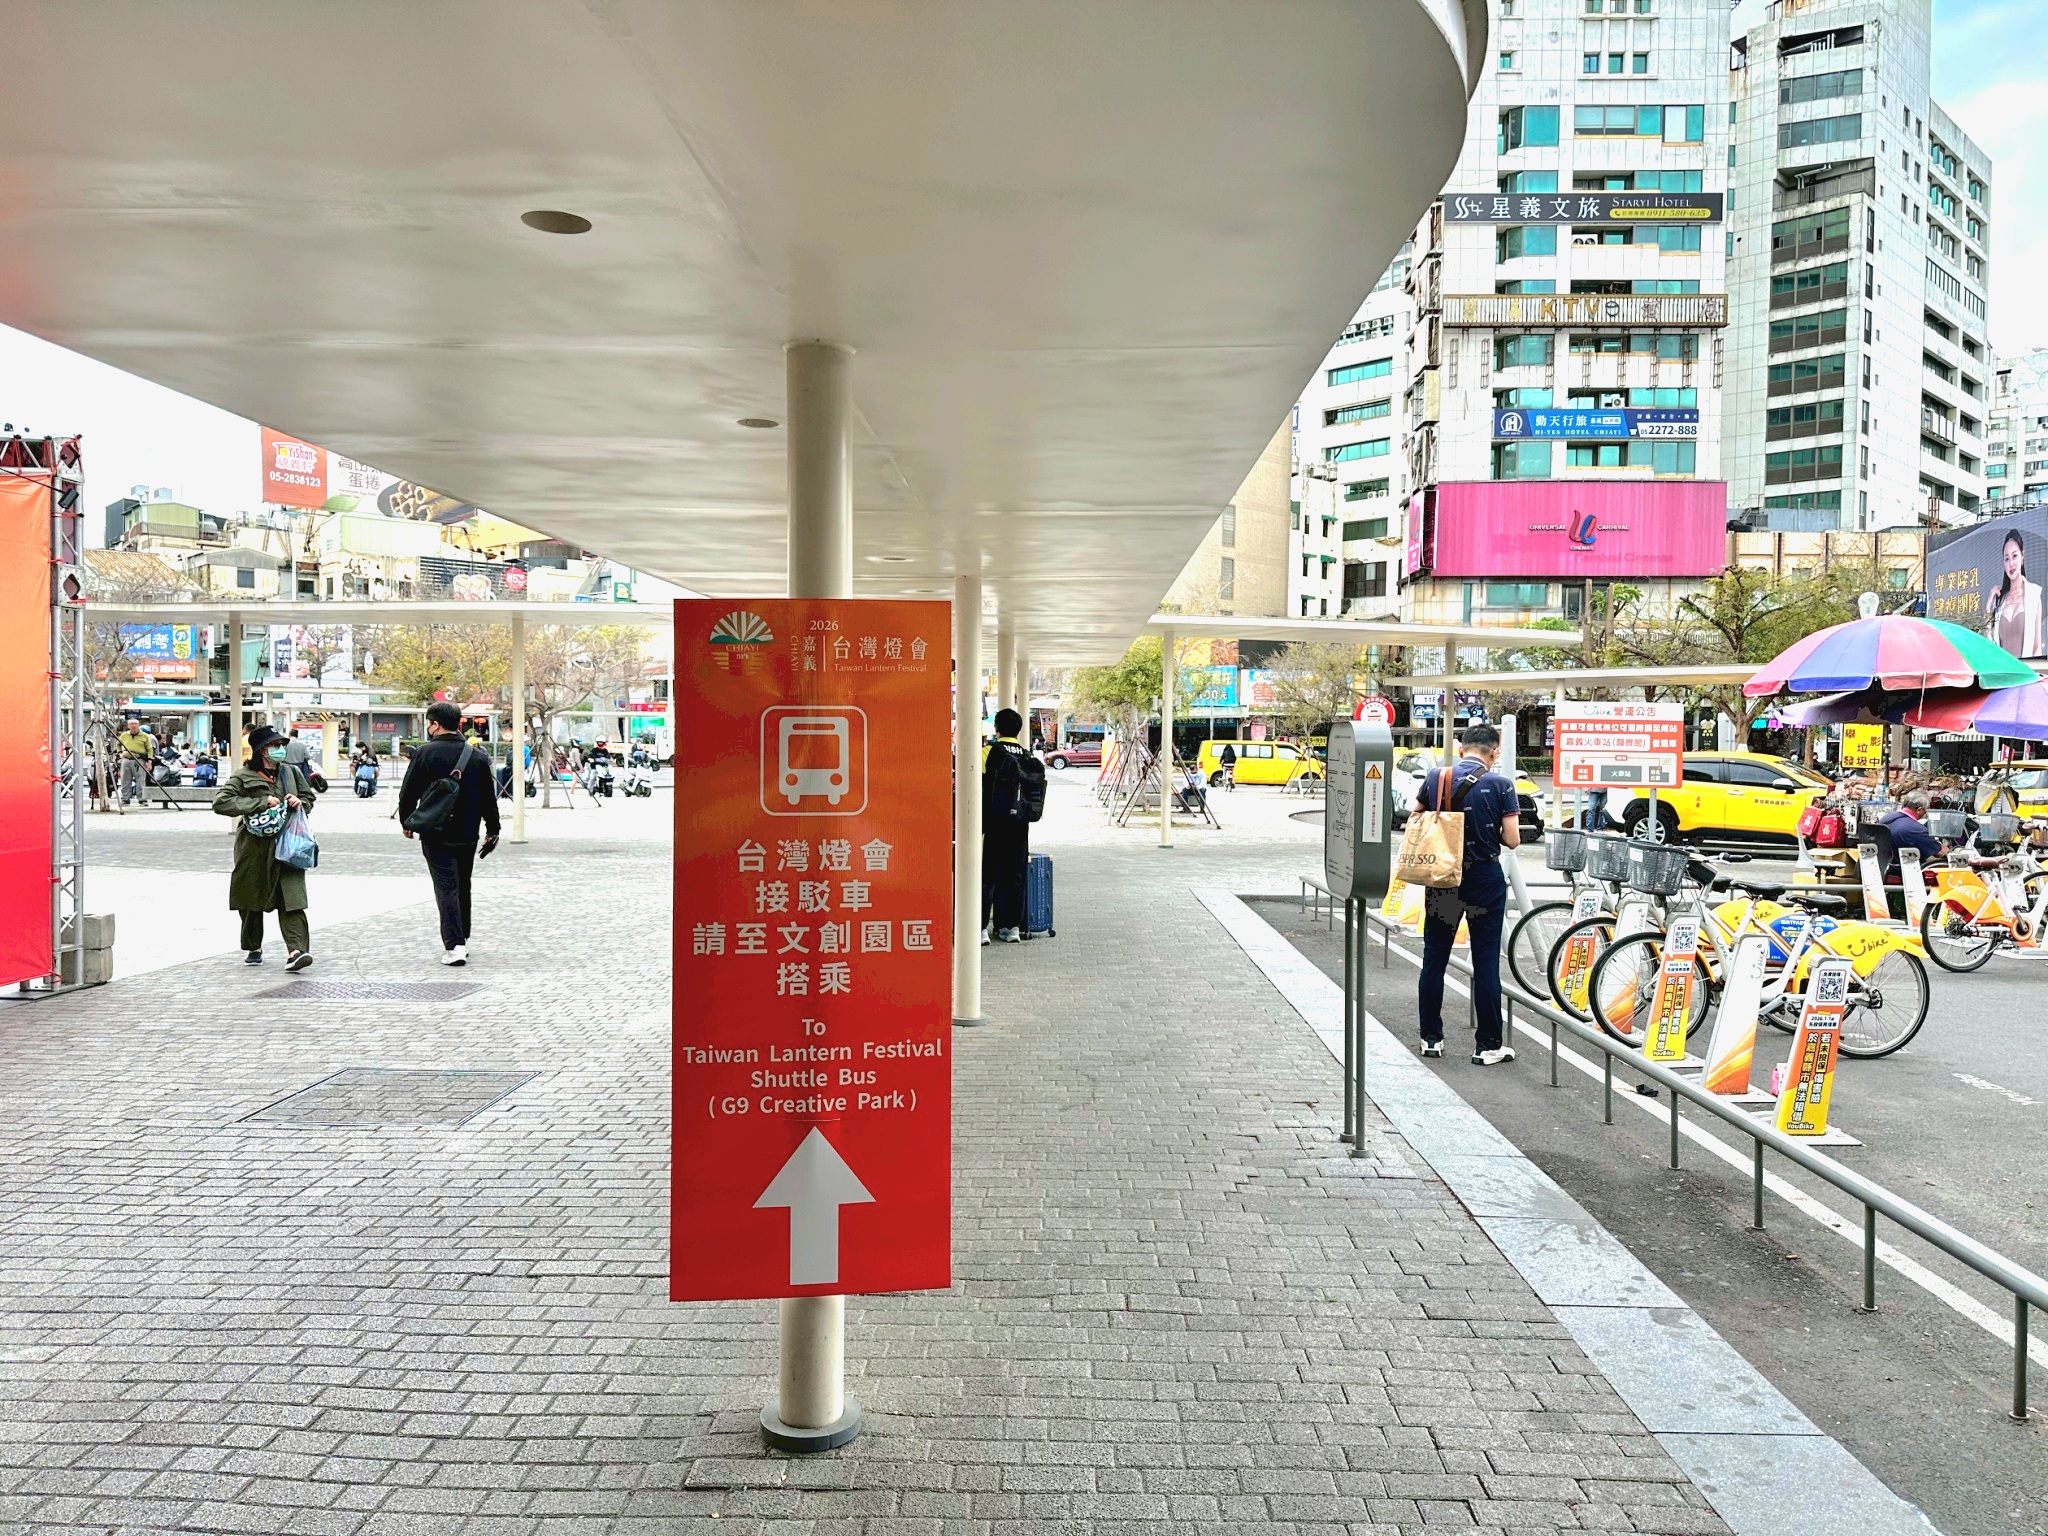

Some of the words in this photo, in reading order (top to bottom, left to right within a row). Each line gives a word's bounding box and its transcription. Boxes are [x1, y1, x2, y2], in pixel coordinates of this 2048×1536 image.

[1490, 197, 1600, 219] 星義文旅
[1655, 197, 1692, 207] HOTEL
[1540, 299, 1600, 319] KTV
[1648, 425, 1698, 435] 2272-888
[269, 470, 321, 488] 05-2838123
[348, 471, 381, 491] 蛋捲
[1934, 567, 1980, 593] 專業隆乳
[1934, 592, 1980, 616] 醫療團隊
[810, 620, 839, 631] 2026
[791, 635, 799, 672] CHIAYI
[803, 636, 817, 672] 嘉義
[832, 636, 929, 661] 台灣燈會
[834, 664, 863, 672] Taiwan
[865, 663, 895, 672] Lantern
[898, 663, 927, 672] Festival
[1613, 706, 1657, 717] 營運公告
[737, 838, 893, 873] 台灣燈會
[1399, 853, 1437, 865] ESPRSSO
[756, 879, 873, 914] 接駁車
[693, 920, 934, 956] 請至文創園區
[776, 961, 852, 996] 搭乘
[801, 1019, 826, 1036] To
[683, 1046, 759, 1063] Taiwan
[770, 1045, 852, 1062] Lantern
[863, 1039, 942, 1060] Festival
[751, 1068, 828, 1088] Shuttle
[839, 1068, 877, 1086] Bus
[759, 1093, 847, 1114] Creative
[1787, 1121, 1815, 1130] YouBike
